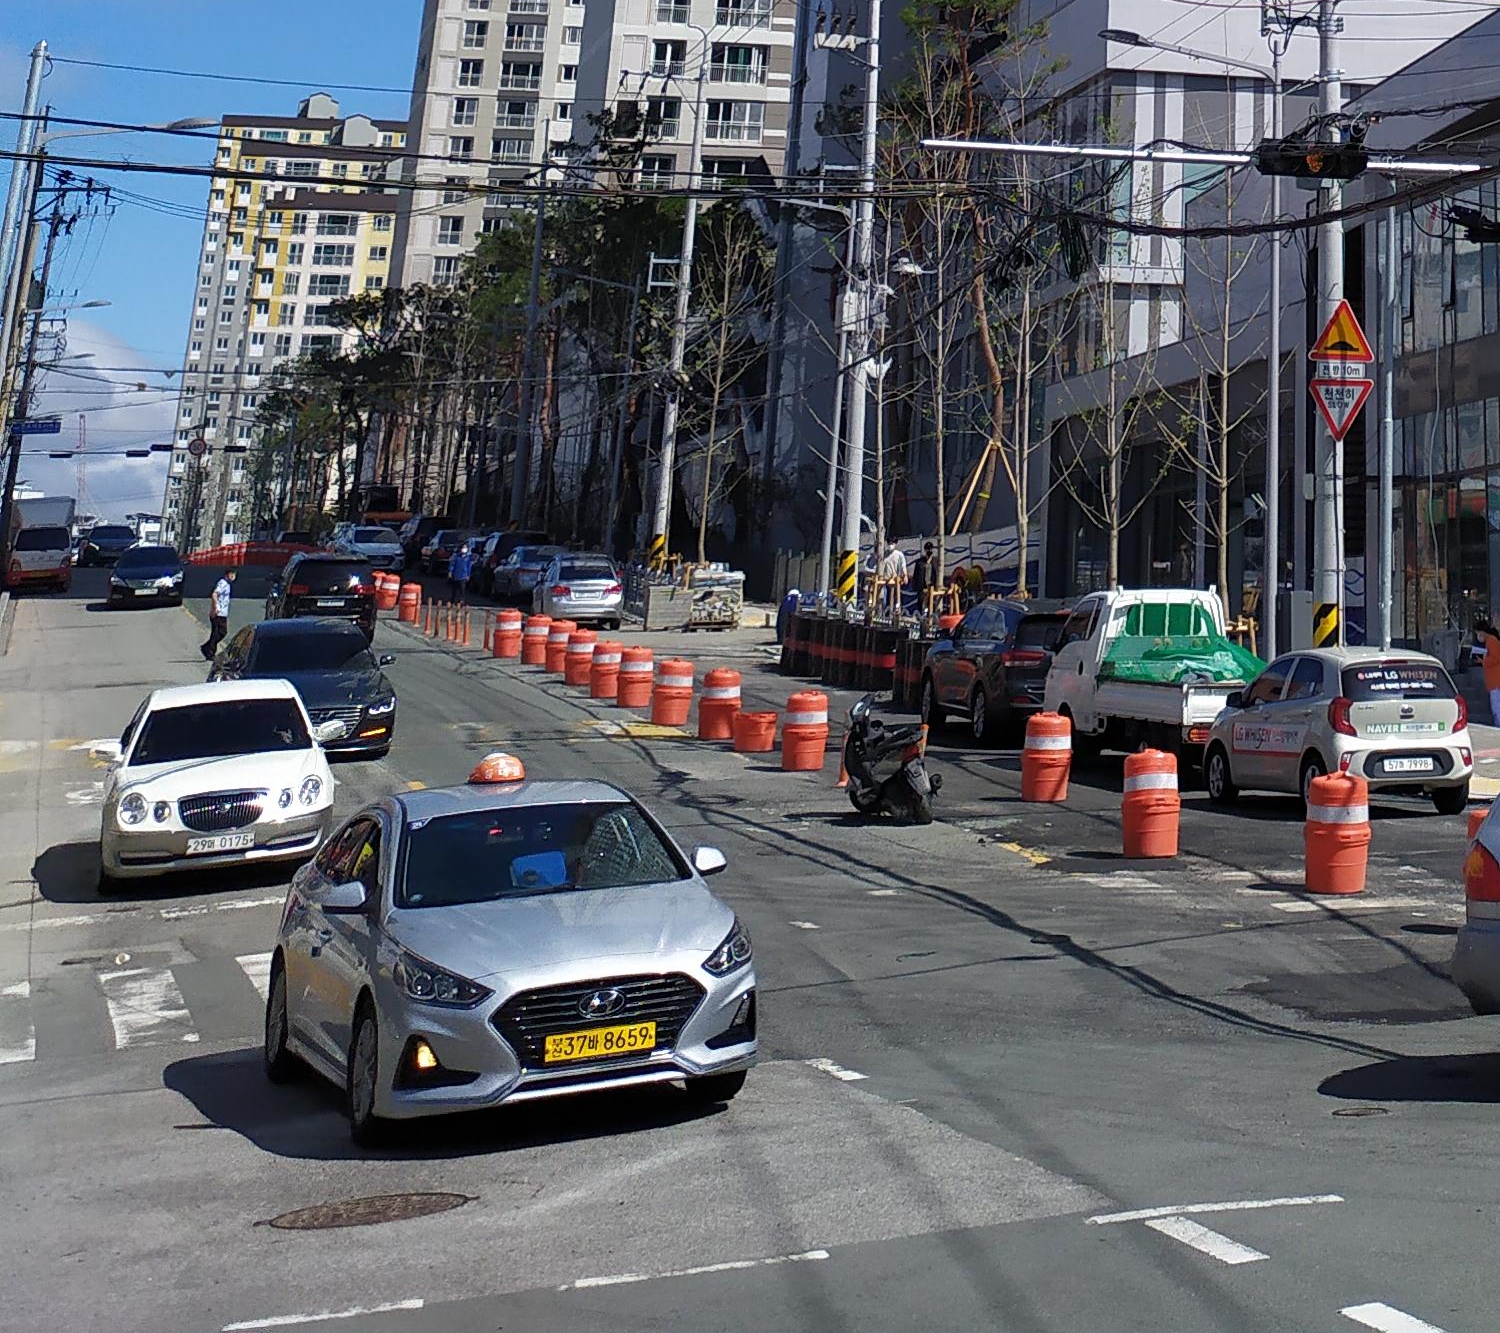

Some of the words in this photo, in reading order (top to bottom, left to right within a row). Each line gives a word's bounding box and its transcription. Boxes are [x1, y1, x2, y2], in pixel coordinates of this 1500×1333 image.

[1342, 365, 1360, 375] 10m
[1324, 388, 1355, 400] 천천히
[1384, 671, 1398, 680] LG
[1399, 671, 1438, 681] WHISEN
[1366, 724, 1399, 733] NAVER
[564, 1033, 599, 1056] 37바
[603, 1026, 650, 1051] 8659
